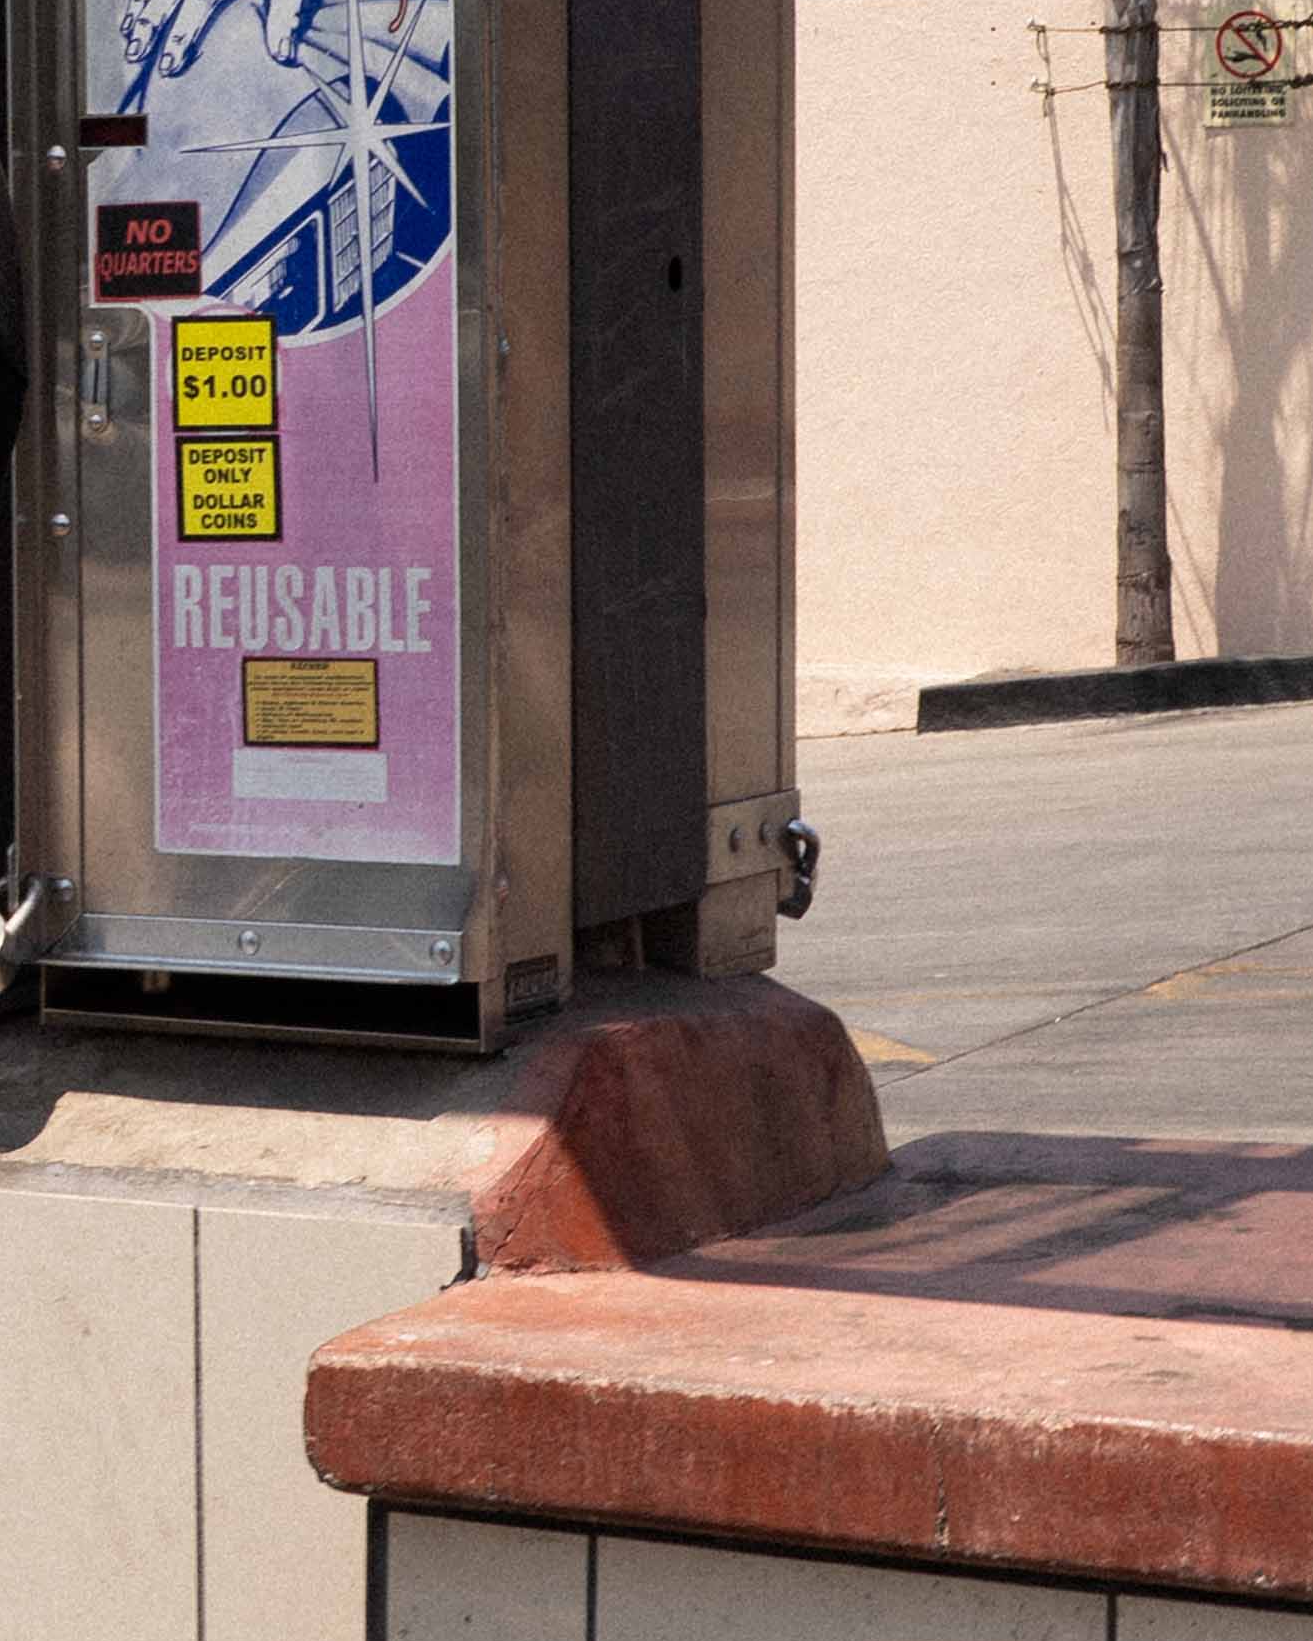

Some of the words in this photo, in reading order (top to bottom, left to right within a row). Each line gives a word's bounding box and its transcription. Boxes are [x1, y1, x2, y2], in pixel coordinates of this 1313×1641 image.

[126, 218, 172, 245] NO
[98, 250, 199, 281] QUARTERS
[181, 345, 267, 362] DEPOSIT
[183, 374, 267, 401] $1.00
[188, 447, 266, 465] DEPOSIT
[203, 468, 253, 484] ONLY
[193, 493, 265, 510] DOLLAR
[200, 513, 258, 530] COINS
[175, 563, 432, 654] REUSABLE
